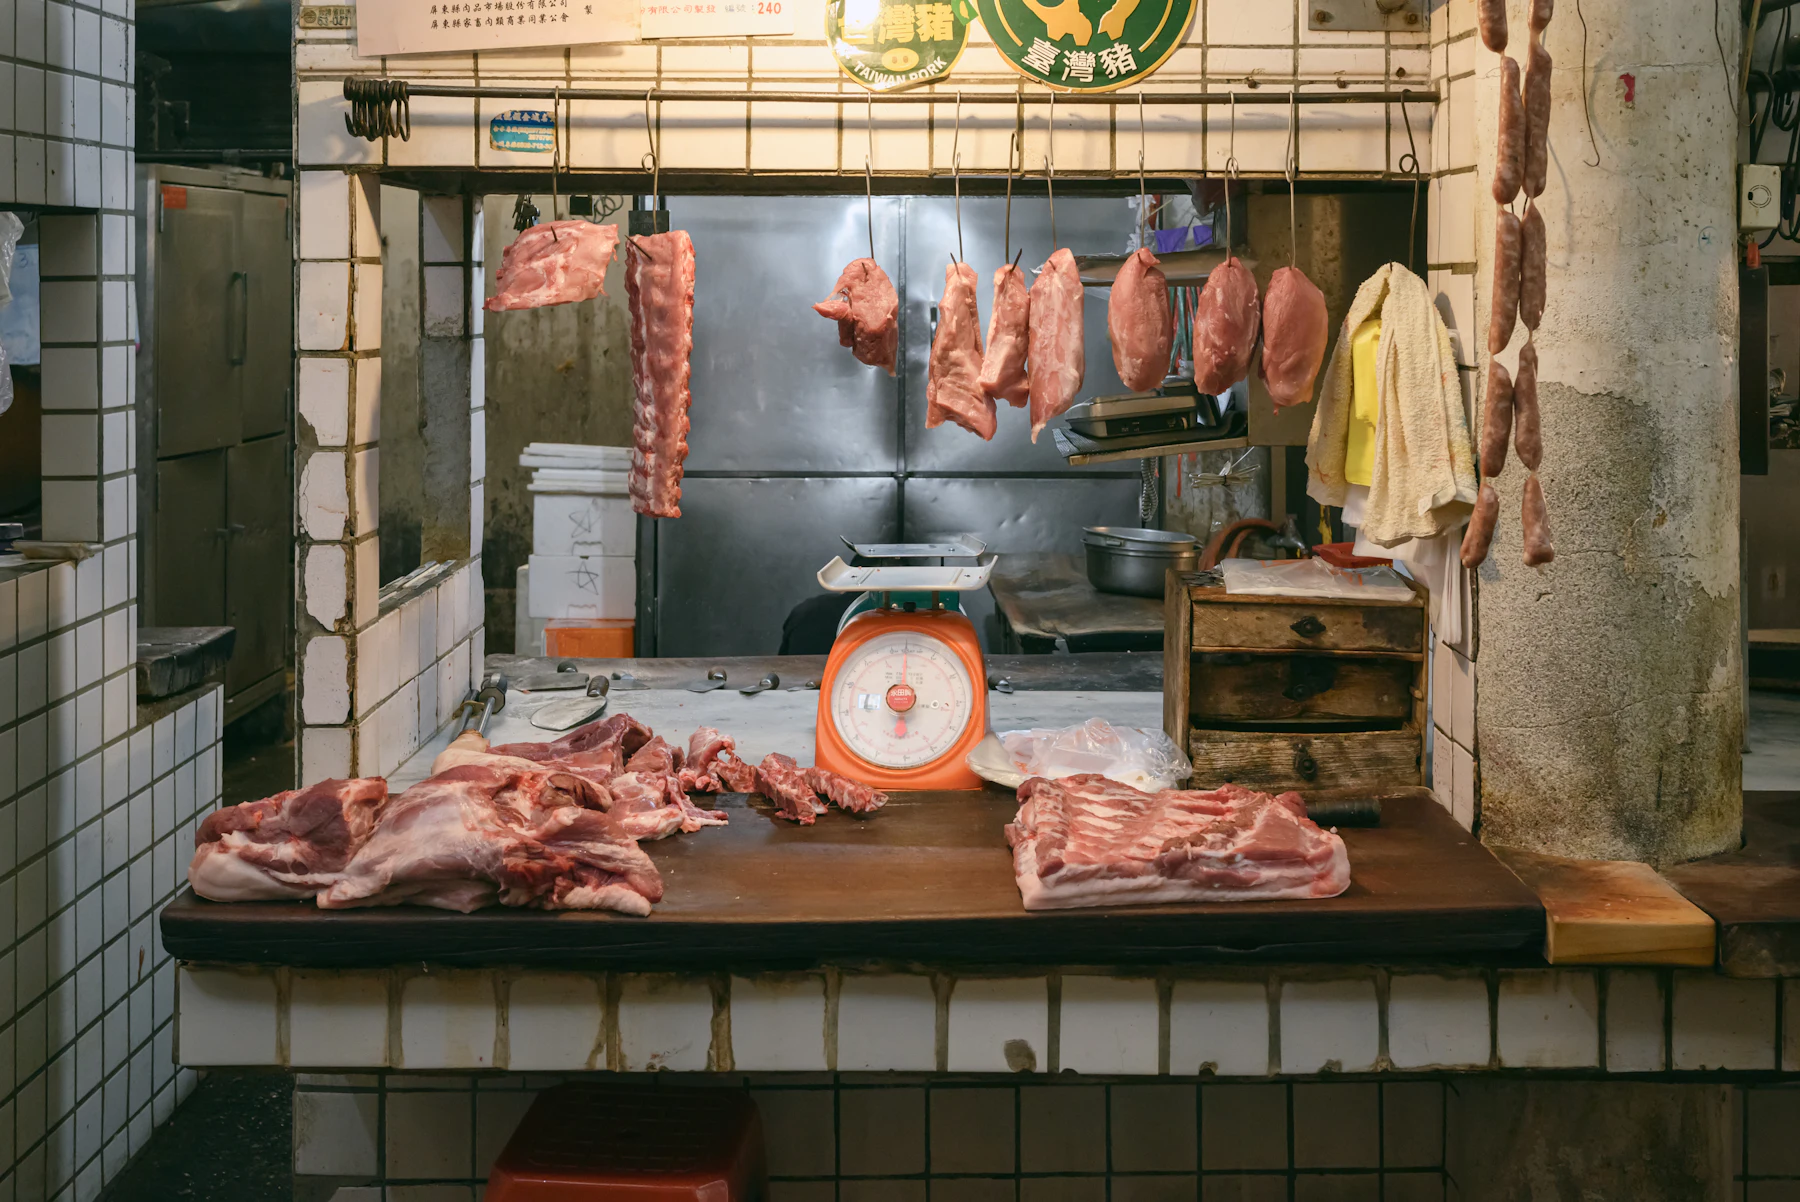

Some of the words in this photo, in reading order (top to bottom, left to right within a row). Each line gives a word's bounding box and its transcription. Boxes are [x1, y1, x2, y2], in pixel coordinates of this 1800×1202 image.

[758, 2, 782, 14] 240
[909, 56, 948, 81] PORK
[1021, 36, 1138, 83] 臺灣豬
